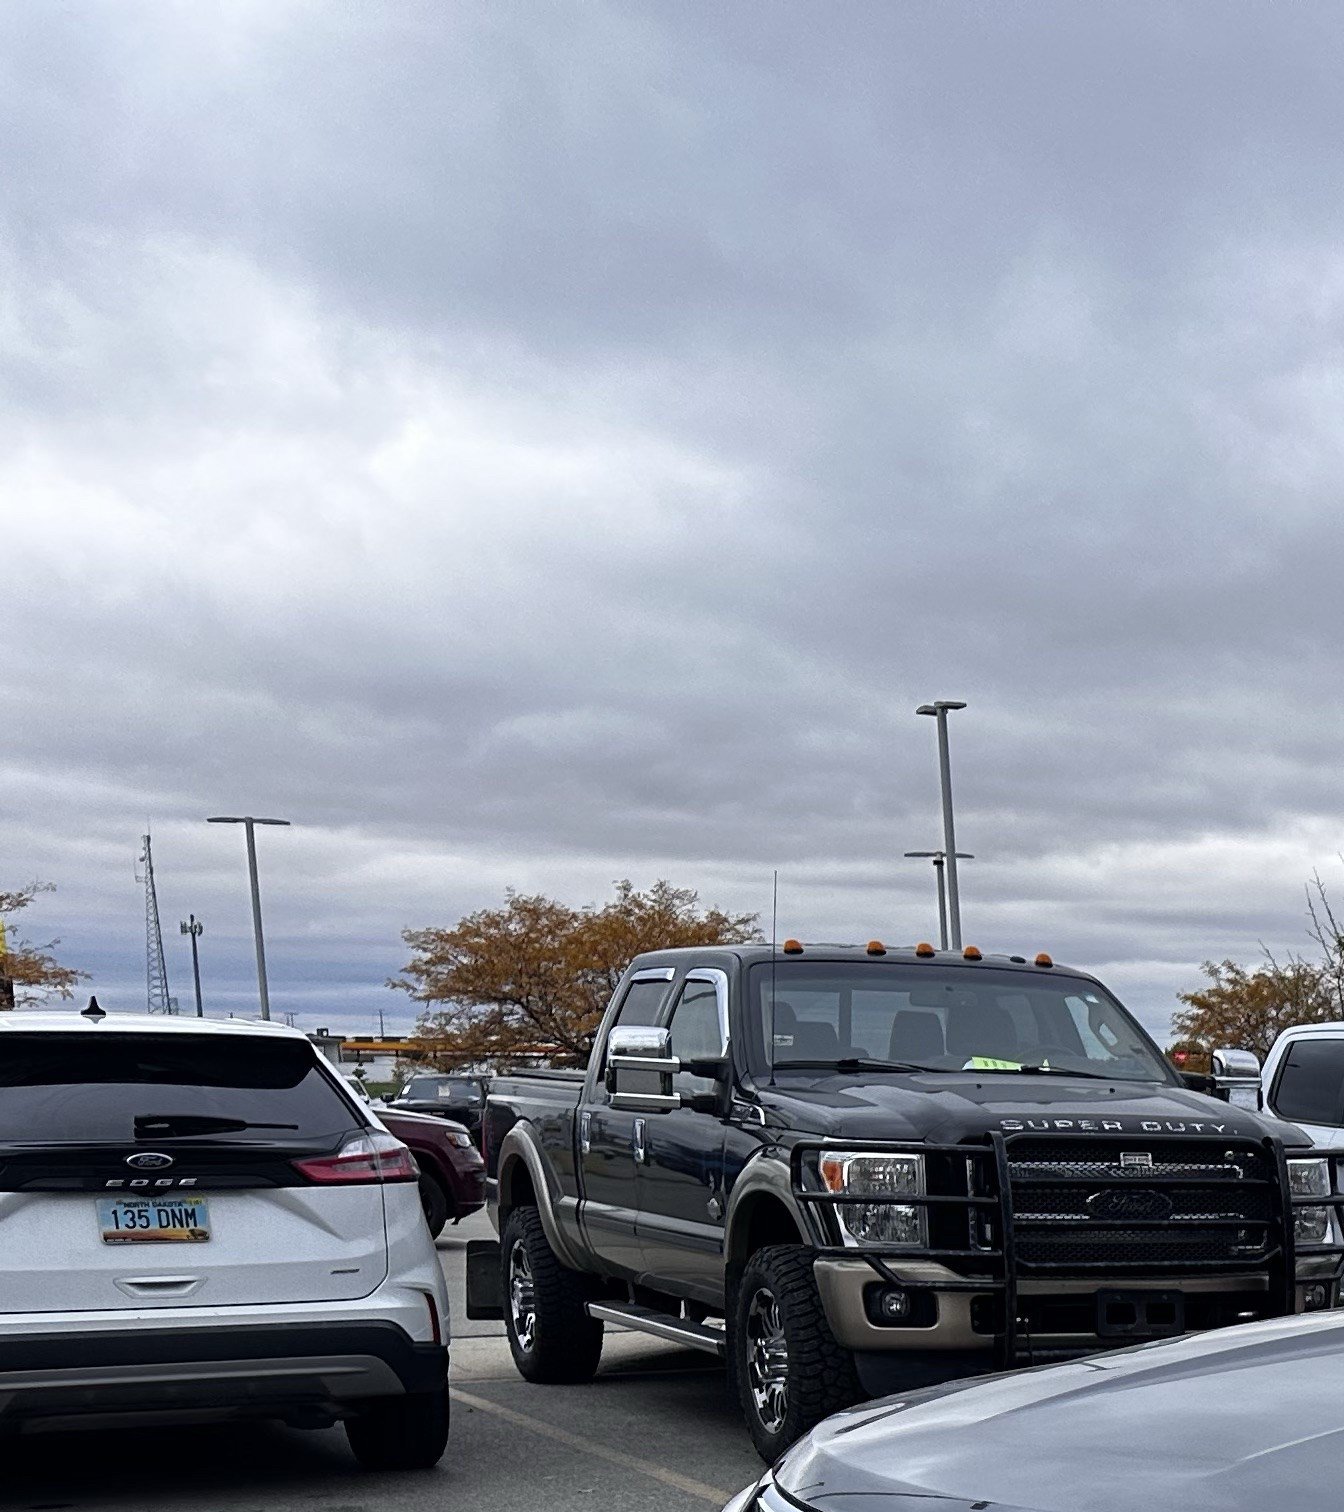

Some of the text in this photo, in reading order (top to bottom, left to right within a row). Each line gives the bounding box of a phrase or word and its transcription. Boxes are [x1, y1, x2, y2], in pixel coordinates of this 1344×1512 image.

[1000, 1119, 1226, 1133] SUPER DUTY
[105, 1178, 197, 1187] EDGE
[111, 1208, 198, 1229] 135 DNM
